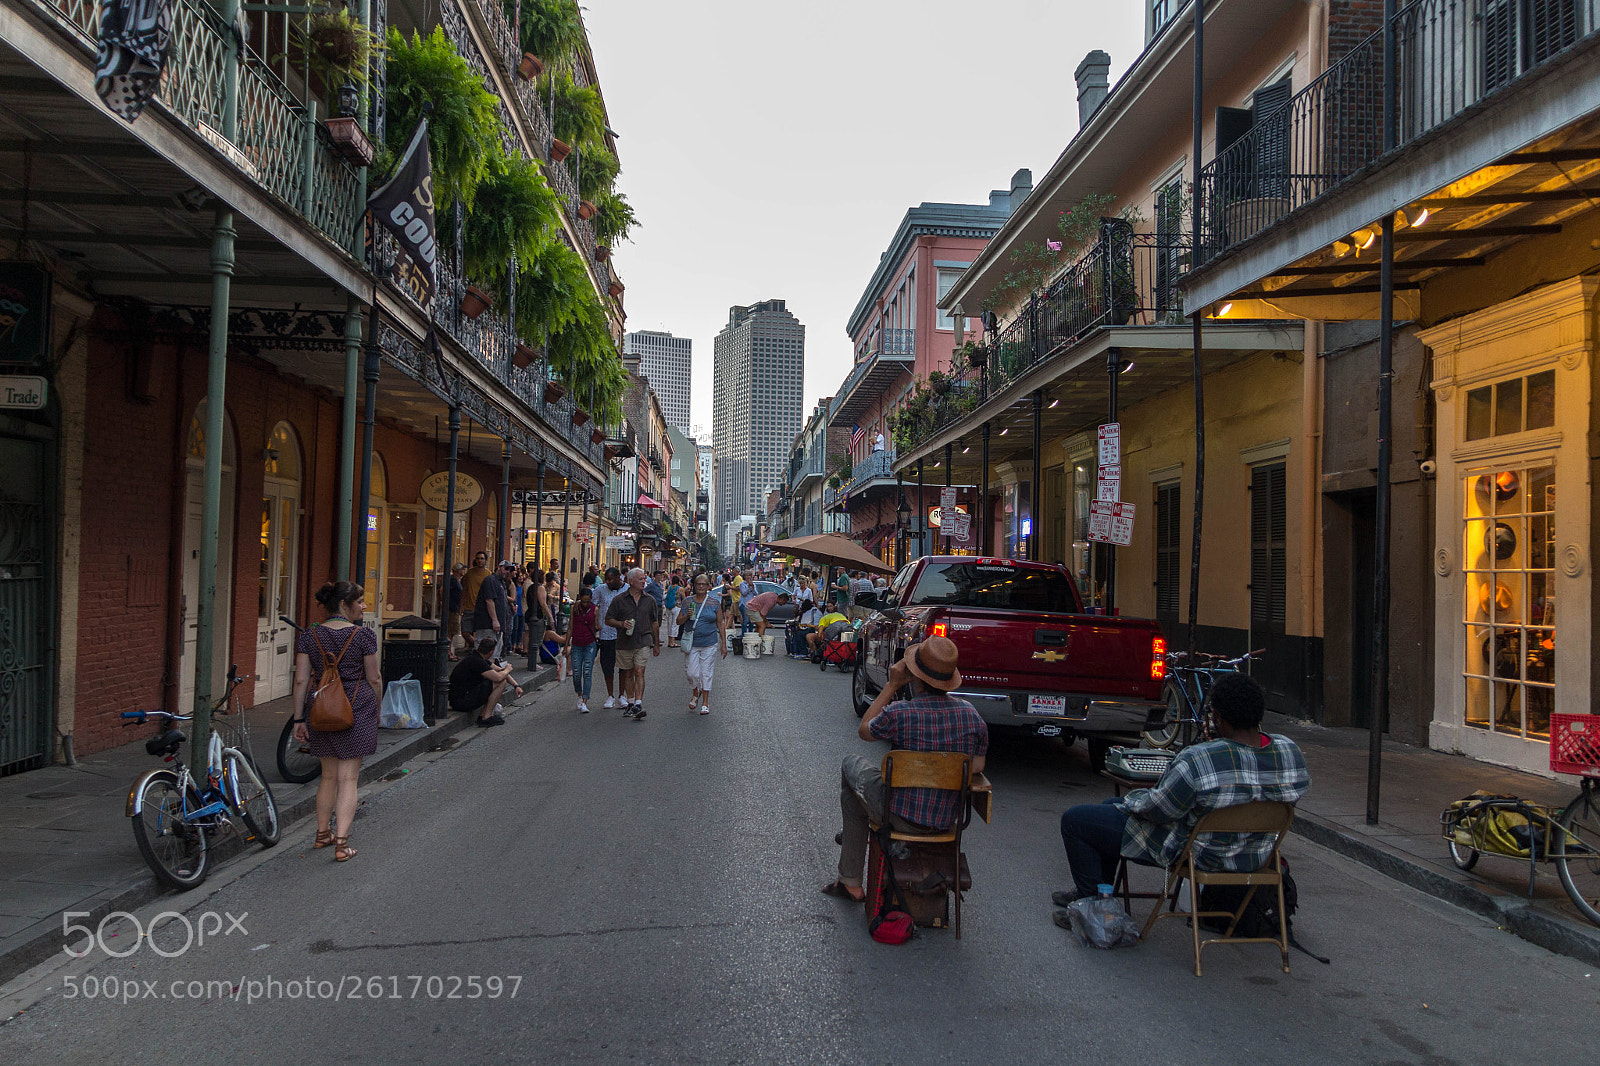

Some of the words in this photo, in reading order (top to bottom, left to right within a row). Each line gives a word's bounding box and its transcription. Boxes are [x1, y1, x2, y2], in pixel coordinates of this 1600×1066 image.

[5, 387, 38, 404] Trade
[1099, 428, 1105, 437] NO
[1099, 469, 1105, 477] NO
[429, 475, 474, 488] FORVER
[259, 631, 269, 644] 706
[961, 674, 1009, 683] ILVERADO
